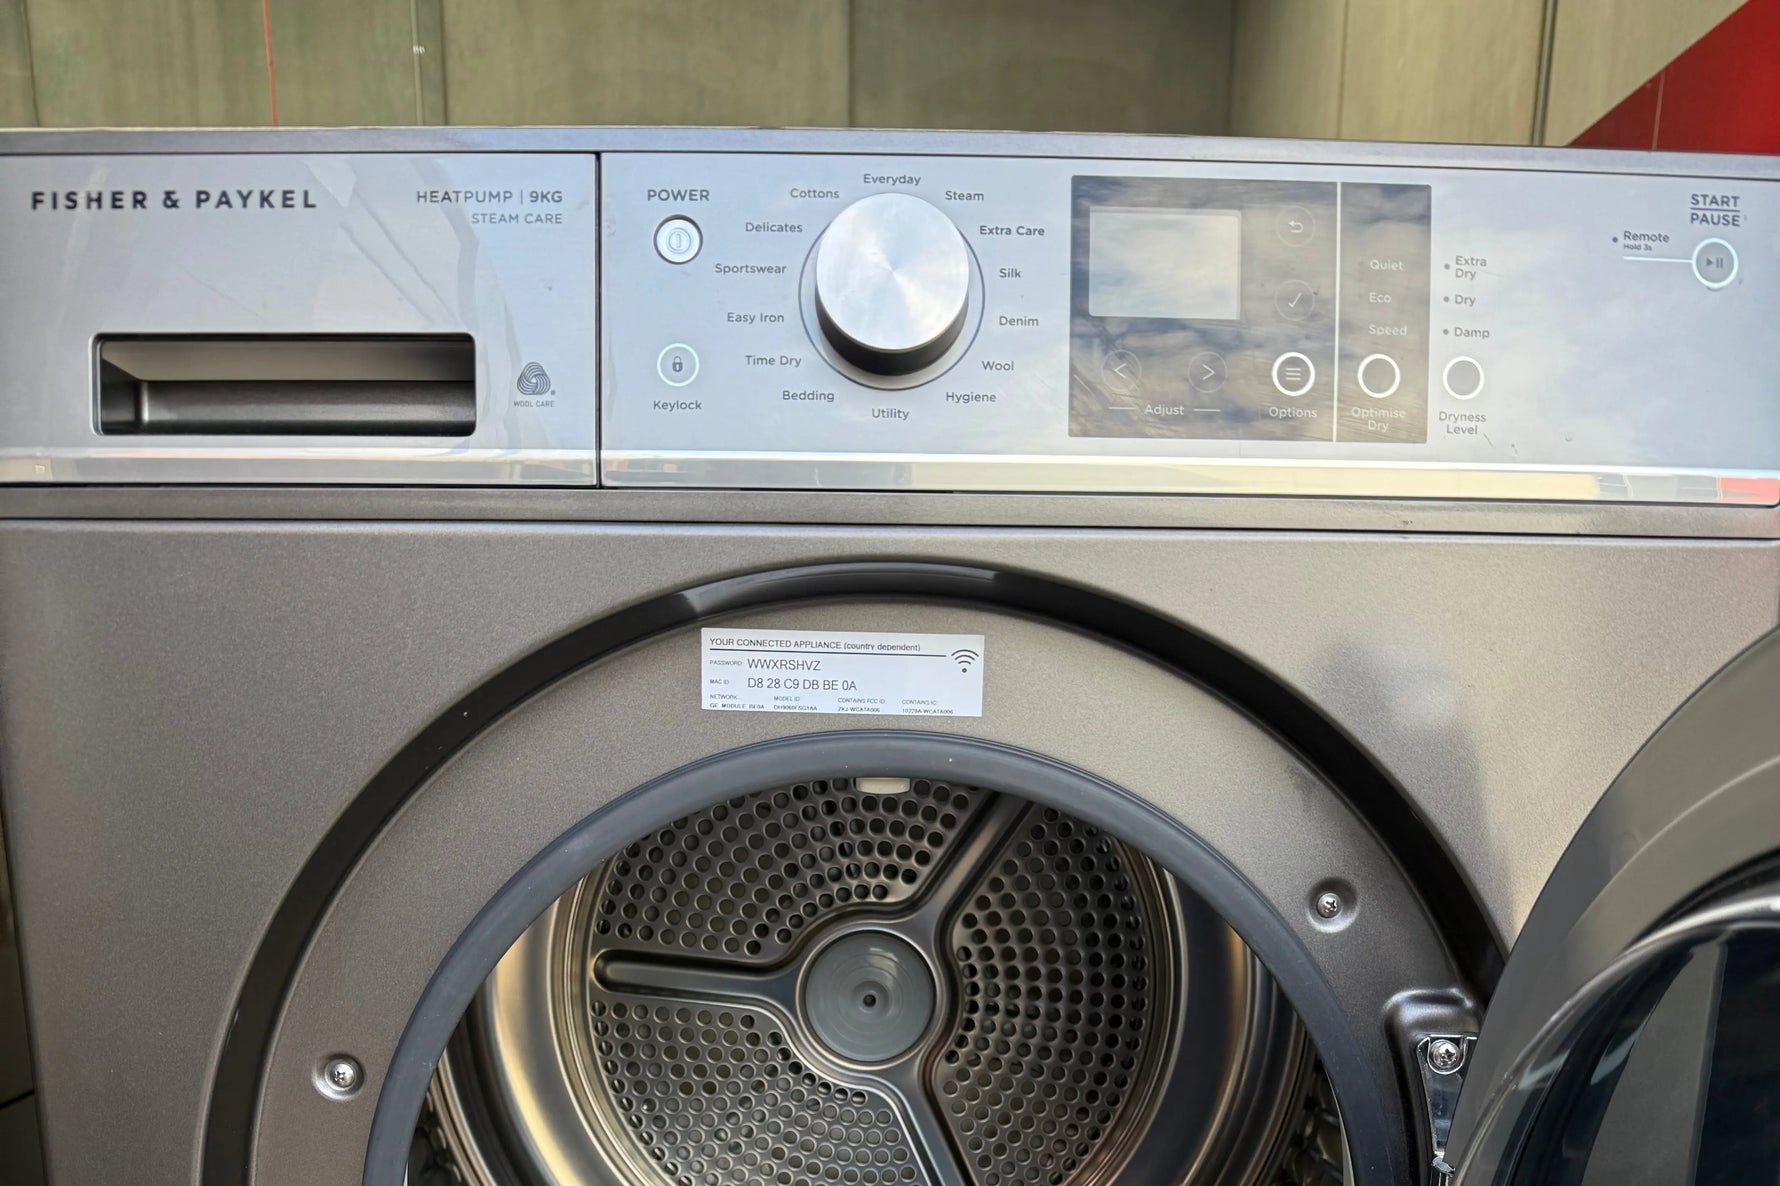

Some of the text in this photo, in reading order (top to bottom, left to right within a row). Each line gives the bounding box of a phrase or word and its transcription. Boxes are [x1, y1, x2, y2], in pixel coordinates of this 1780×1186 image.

[863, 174, 921, 187] Everyday
[32, 190, 317, 211] FISHER & PAYKEL
[417, 190, 513, 204] HEATPUMP
[529, 190, 562, 203] 9KG
[647, 188, 710, 202] POWER
[790, 188, 839, 200] Cottons
[945, 191, 984, 201] Steam
[1690, 194, 1740, 207] START
[471, 213, 562, 224] STEAM CARE
[1690, 213, 1741, 227] PAUSE
[745, 222, 803, 233] Delicates
[979, 225, 1045, 237] Extra Care
[1623, 231, 1670, 243] Remote
[1370, 259, 1403, 272] Quiet
[1456, 256, 1487, 267] Extra
[715, 263, 786, 276] Sportswear
[999, 267, 1022, 279] Silk
[1455, 268, 1476, 281] Dry
[1369, 292, 1392, 303] Eco
[1454, 294, 1476, 307] Dry
[727, 312, 784, 325] Easy Iron
[999, 315, 1039, 326] Denim
[1369, 325, 1408, 338] Speed
[1454, 327, 1490, 340] Damp
[745, 355, 802, 369] Time Dry
[982, 360, 1014, 372] Wool
[783, 390, 835, 403] Bedding
[946, 391, 996, 405] Hygiene
[514, 400, 555, 408] WOOL CARE
[653, 399, 702, 412] Keylock
[1145, 404, 1184, 417] Adjust
[872, 407, 909, 421] Utility
[1269, 406, 1317, 419] Options
[1351, 406, 1407, 421] Optimise
[1439, 412, 1486, 425] Dryness
[1367, 420, 1389, 433] Dry
[1446, 424, 1478, 435] Level
[710, 638, 921, 652] YOUR CONNECTED APPLIANCE (country dependent)
[747, 659, 820, 671] WWXRSHVZ
[748, 678, 764, 689] D8
[767, 679, 781, 689] 28
[784, 679, 799, 689] C9
[803, 680, 819, 690] DB
[823, 680, 839, 690] BE
[842, 680, 857, 691] 0A
